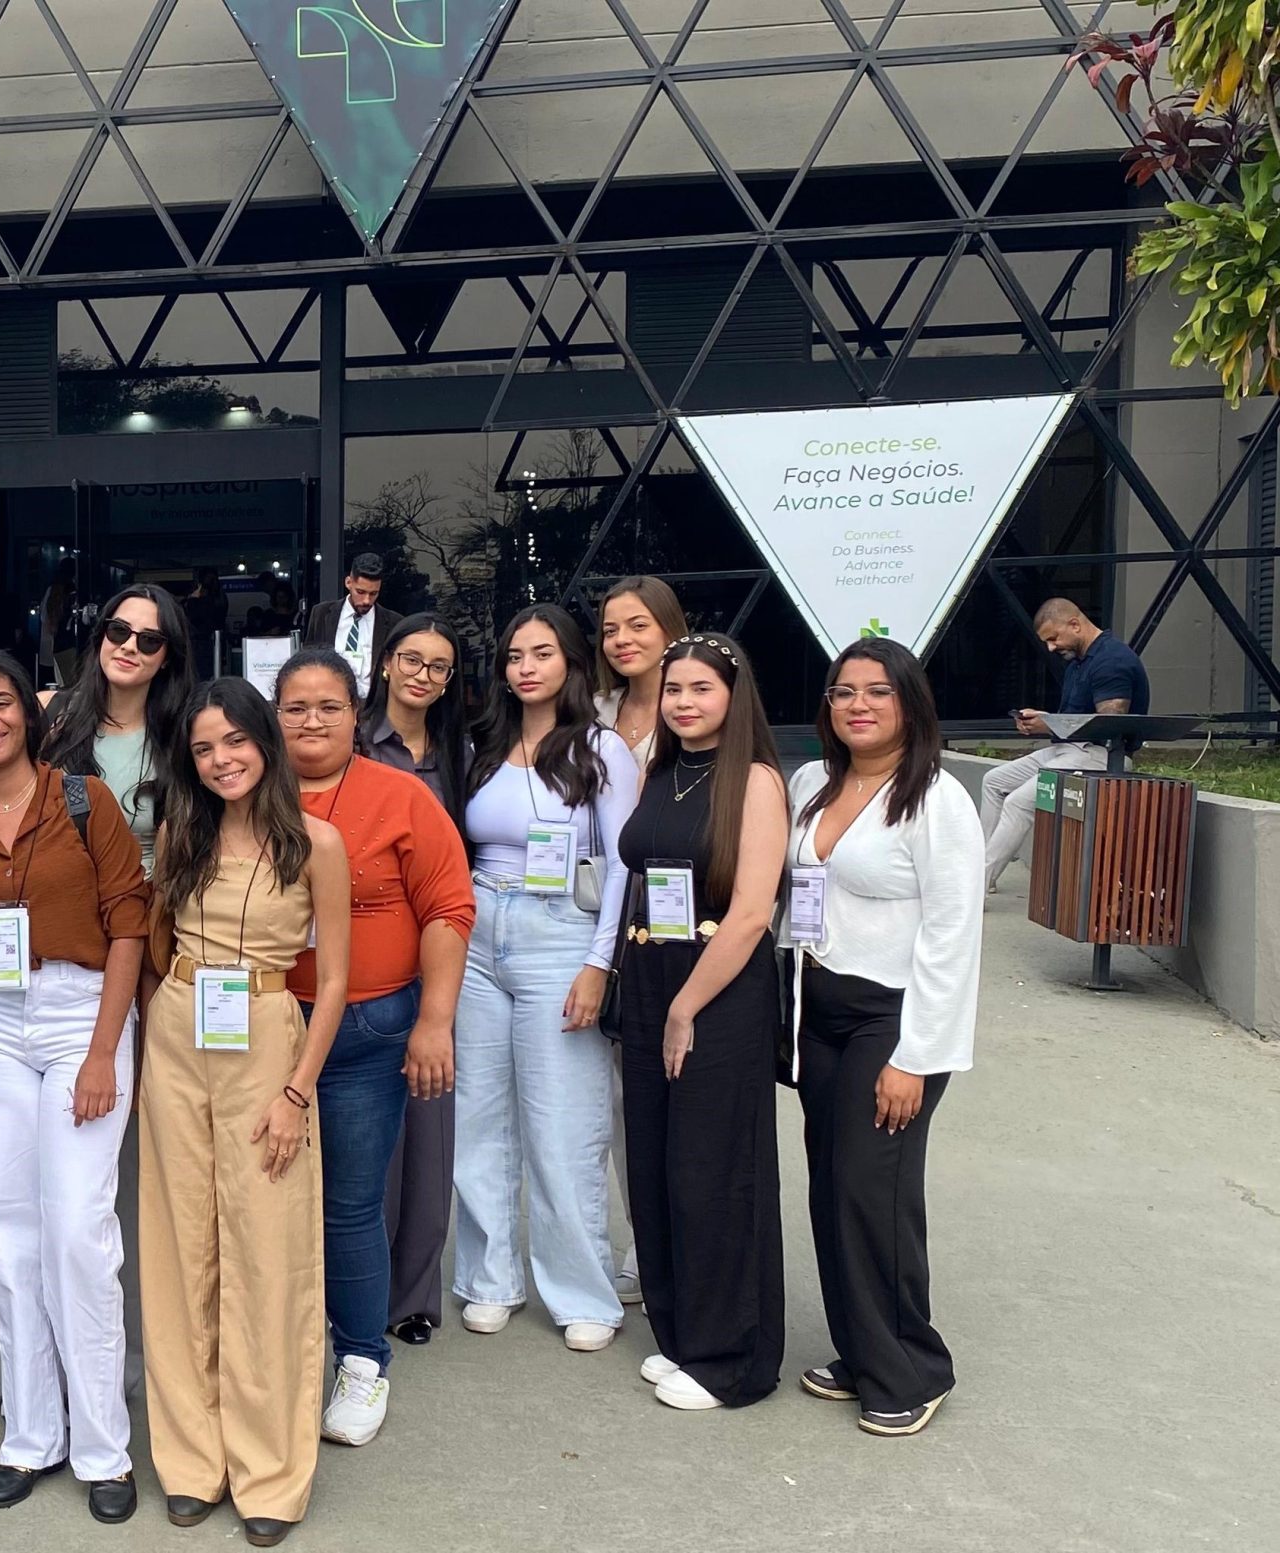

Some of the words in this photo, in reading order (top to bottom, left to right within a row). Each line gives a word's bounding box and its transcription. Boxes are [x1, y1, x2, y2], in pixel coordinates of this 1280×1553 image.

[803, 435, 942, 457] Conecte-se.
[783, 466, 840, 488] Faça
[848, 459, 964, 484] Negócios.
[773, 489, 861, 512] Avance
[868, 494, 883, 508] a
[891, 485, 975, 507] Saúde!
[843, 528, 903, 541] Connect.
[832, 544, 851, 557] Do
[855, 542, 915, 556] Business.
[844, 558, 904, 571] Advance
[835, 572, 914, 587] Healthcare!
